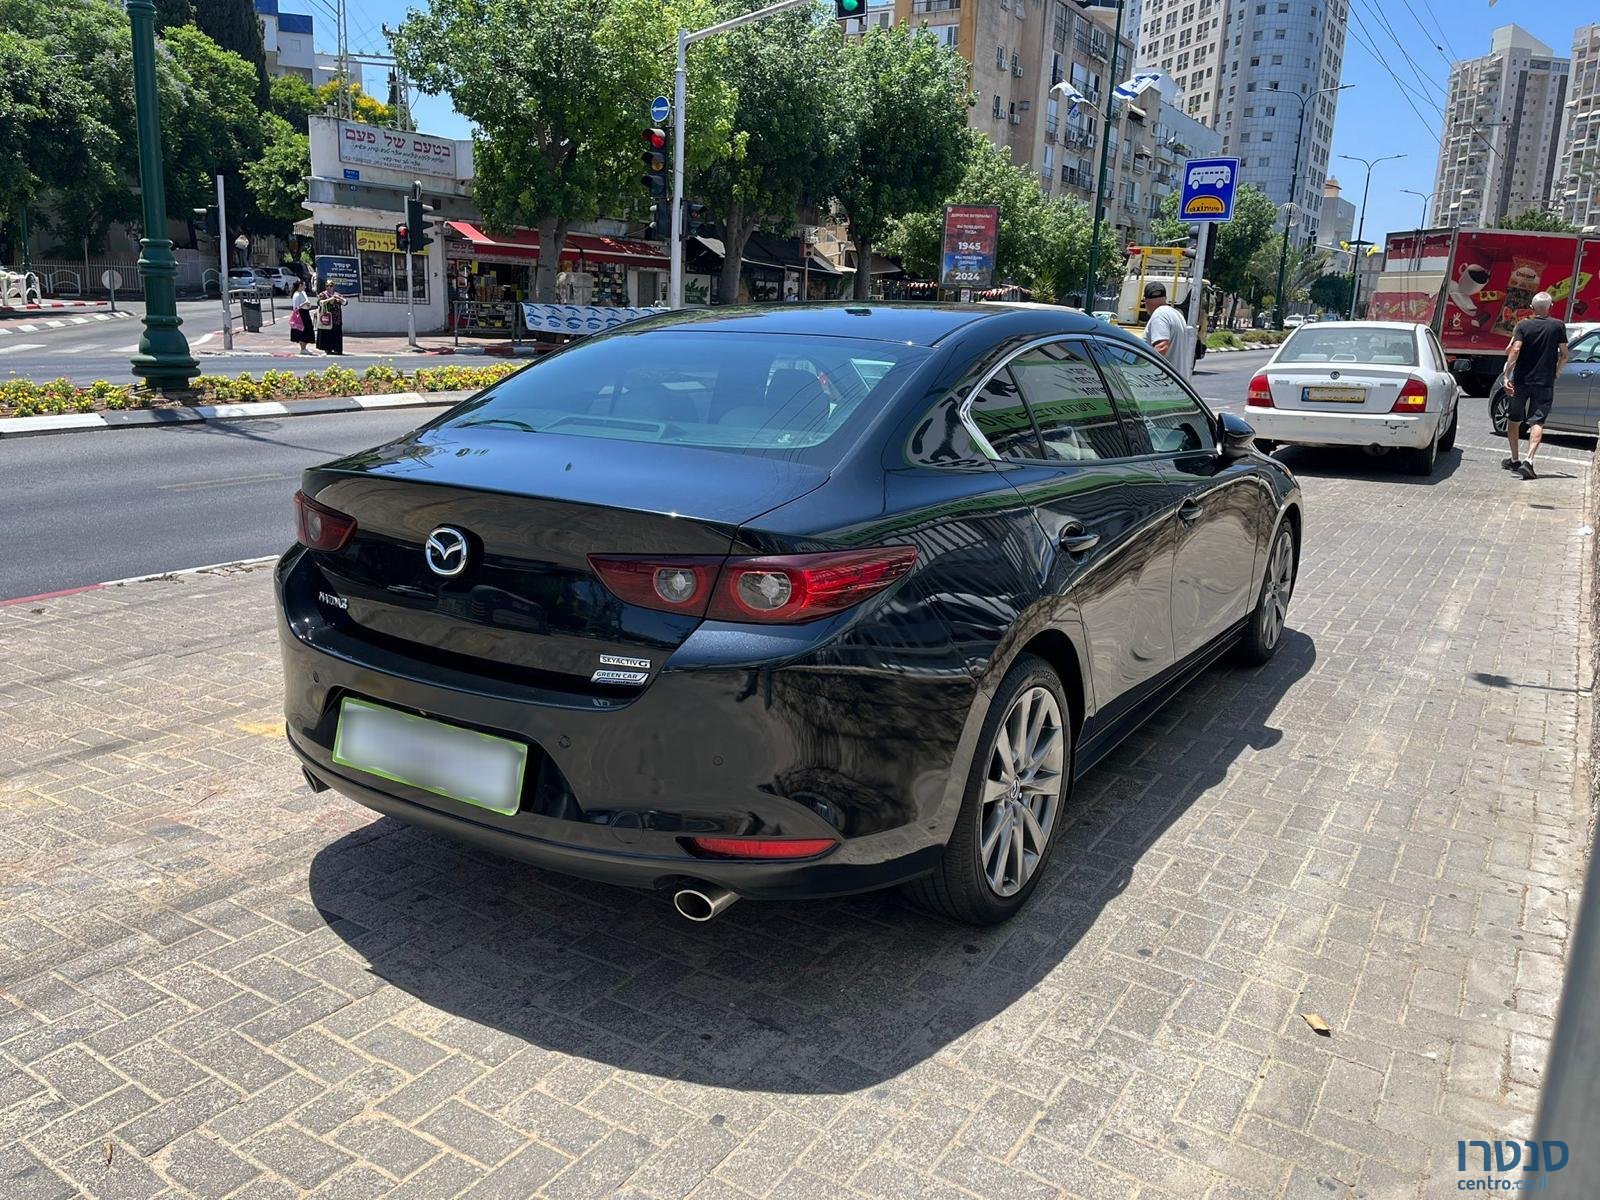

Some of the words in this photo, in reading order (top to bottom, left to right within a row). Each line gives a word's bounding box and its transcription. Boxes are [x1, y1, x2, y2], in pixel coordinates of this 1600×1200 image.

[345, 128, 376, 144] פעם
[383, 131, 406, 149] של
[413, 140, 450, 157] בטעם
[958, 242, 981, 250] 1945
[955, 272, 980, 280] 2024
[596, 671, 621, 679] GREEN
